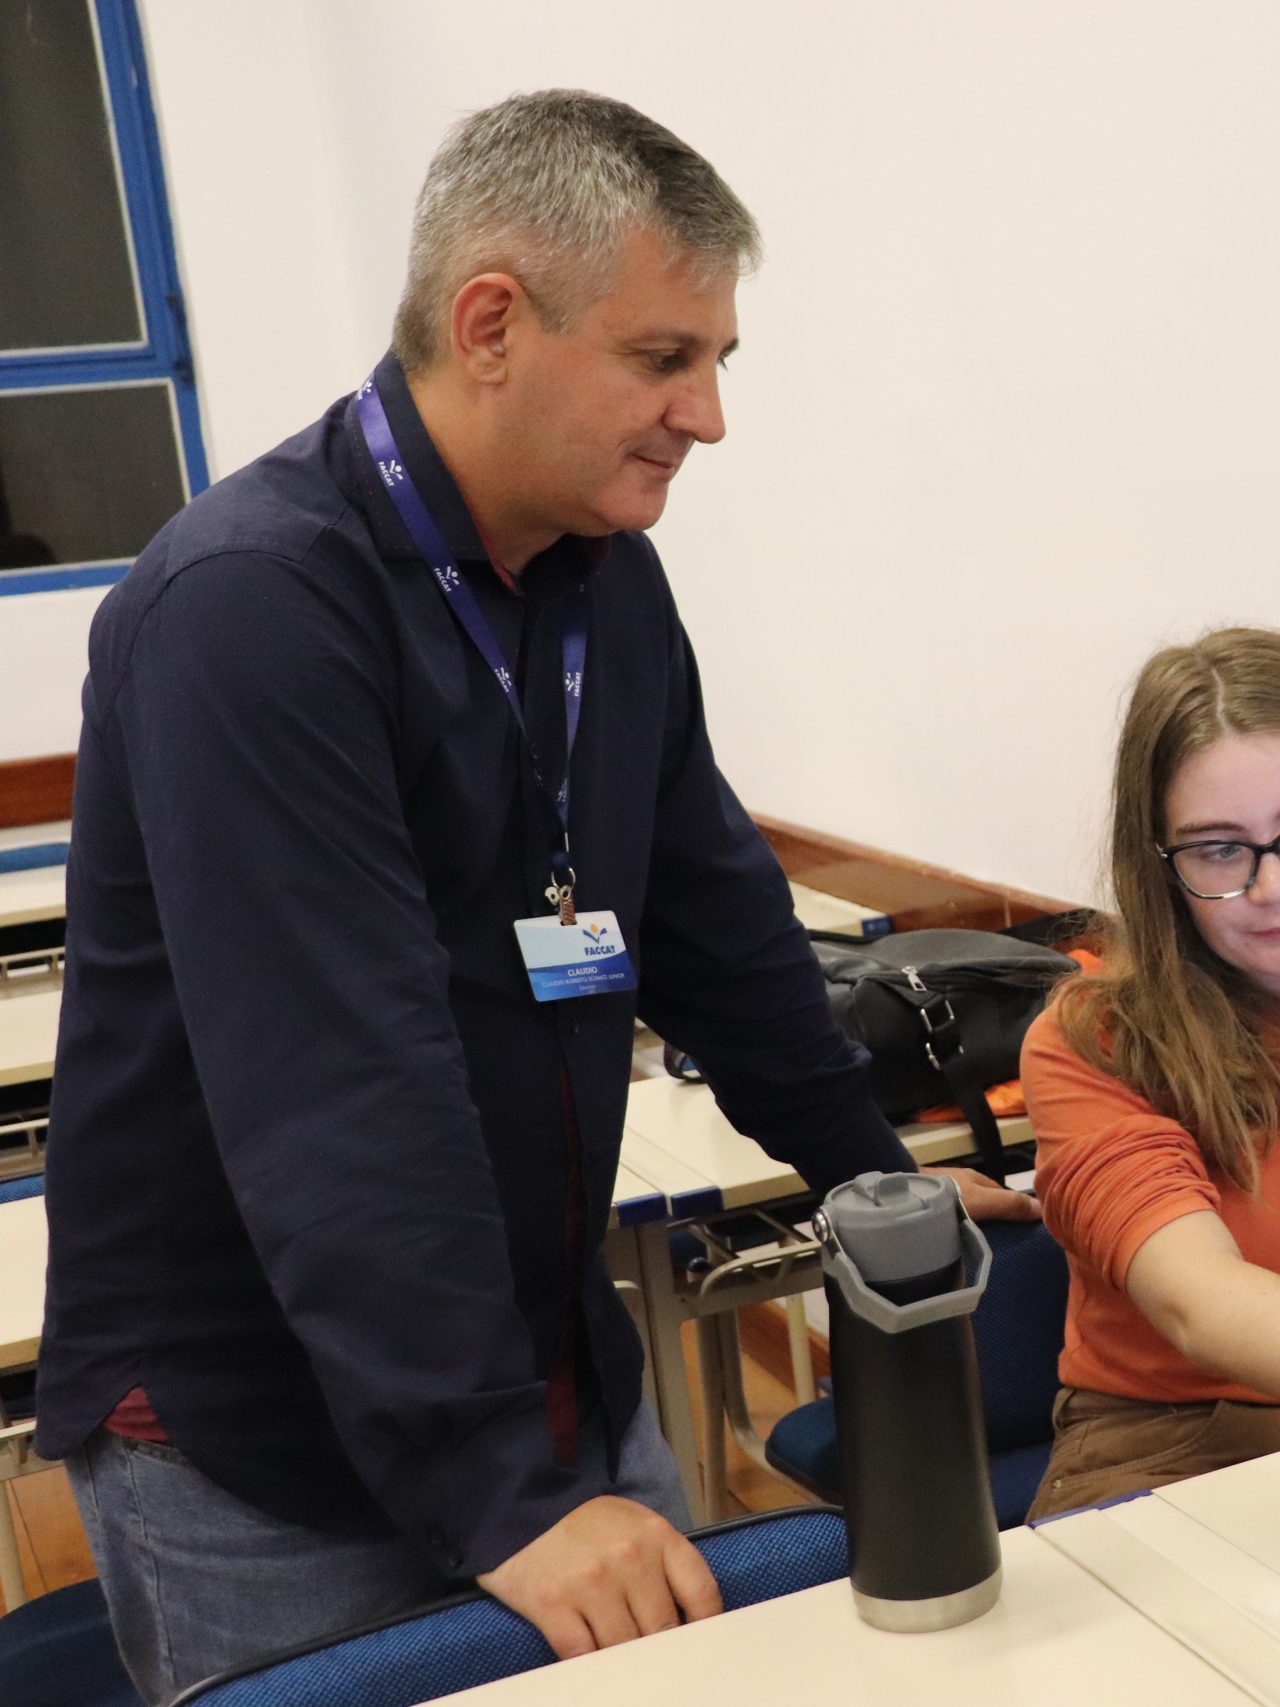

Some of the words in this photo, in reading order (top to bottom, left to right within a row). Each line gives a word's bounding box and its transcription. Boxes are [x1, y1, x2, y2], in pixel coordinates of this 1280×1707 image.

[378, 461, 395, 487] FACCAT
[434, 567, 452, 592] FACCAT
[585, 945, 615, 956] FACCAT
[567, 966, 598, 977] CLAUDIO
